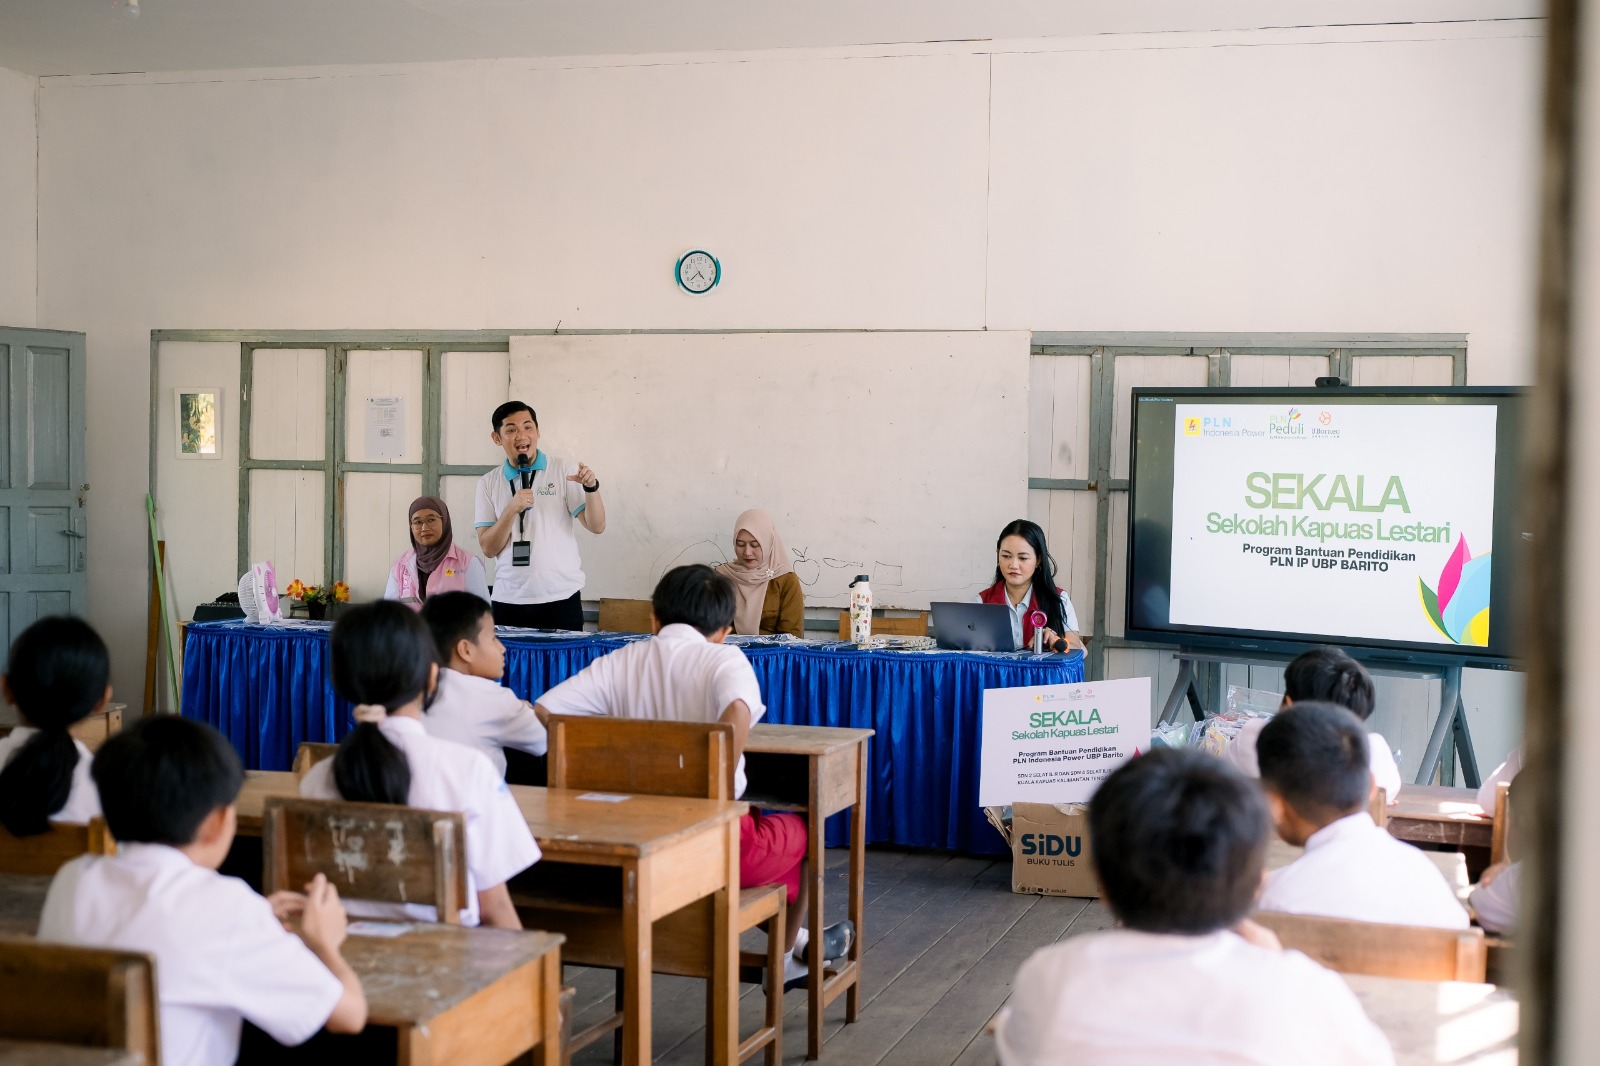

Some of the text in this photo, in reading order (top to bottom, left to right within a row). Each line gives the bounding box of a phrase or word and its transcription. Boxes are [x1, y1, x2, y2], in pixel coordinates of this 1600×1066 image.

[1204, 417, 1231, 427] PLN
[1270, 415, 1287, 423] PLN
[1203, 428, 1265, 437] Indonesia Power
[1270, 423, 1304, 434] Peduli
[1244, 472, 1411, 513] SEKALA
[1206, 512, 1450, 543] Sekolah Kapuas Lestari
[1243, 544, 1416, 562] Program Bantuan Pendidikan
[1270, 556, 1388, 572] PLN IP UBP BARITO
[1029, 709, 1102, 728] SEKALA
[1012, 725, 1118, 740] Sekolah Kapuas Lestari
[1021, 834, 1081, 857] SiDU
